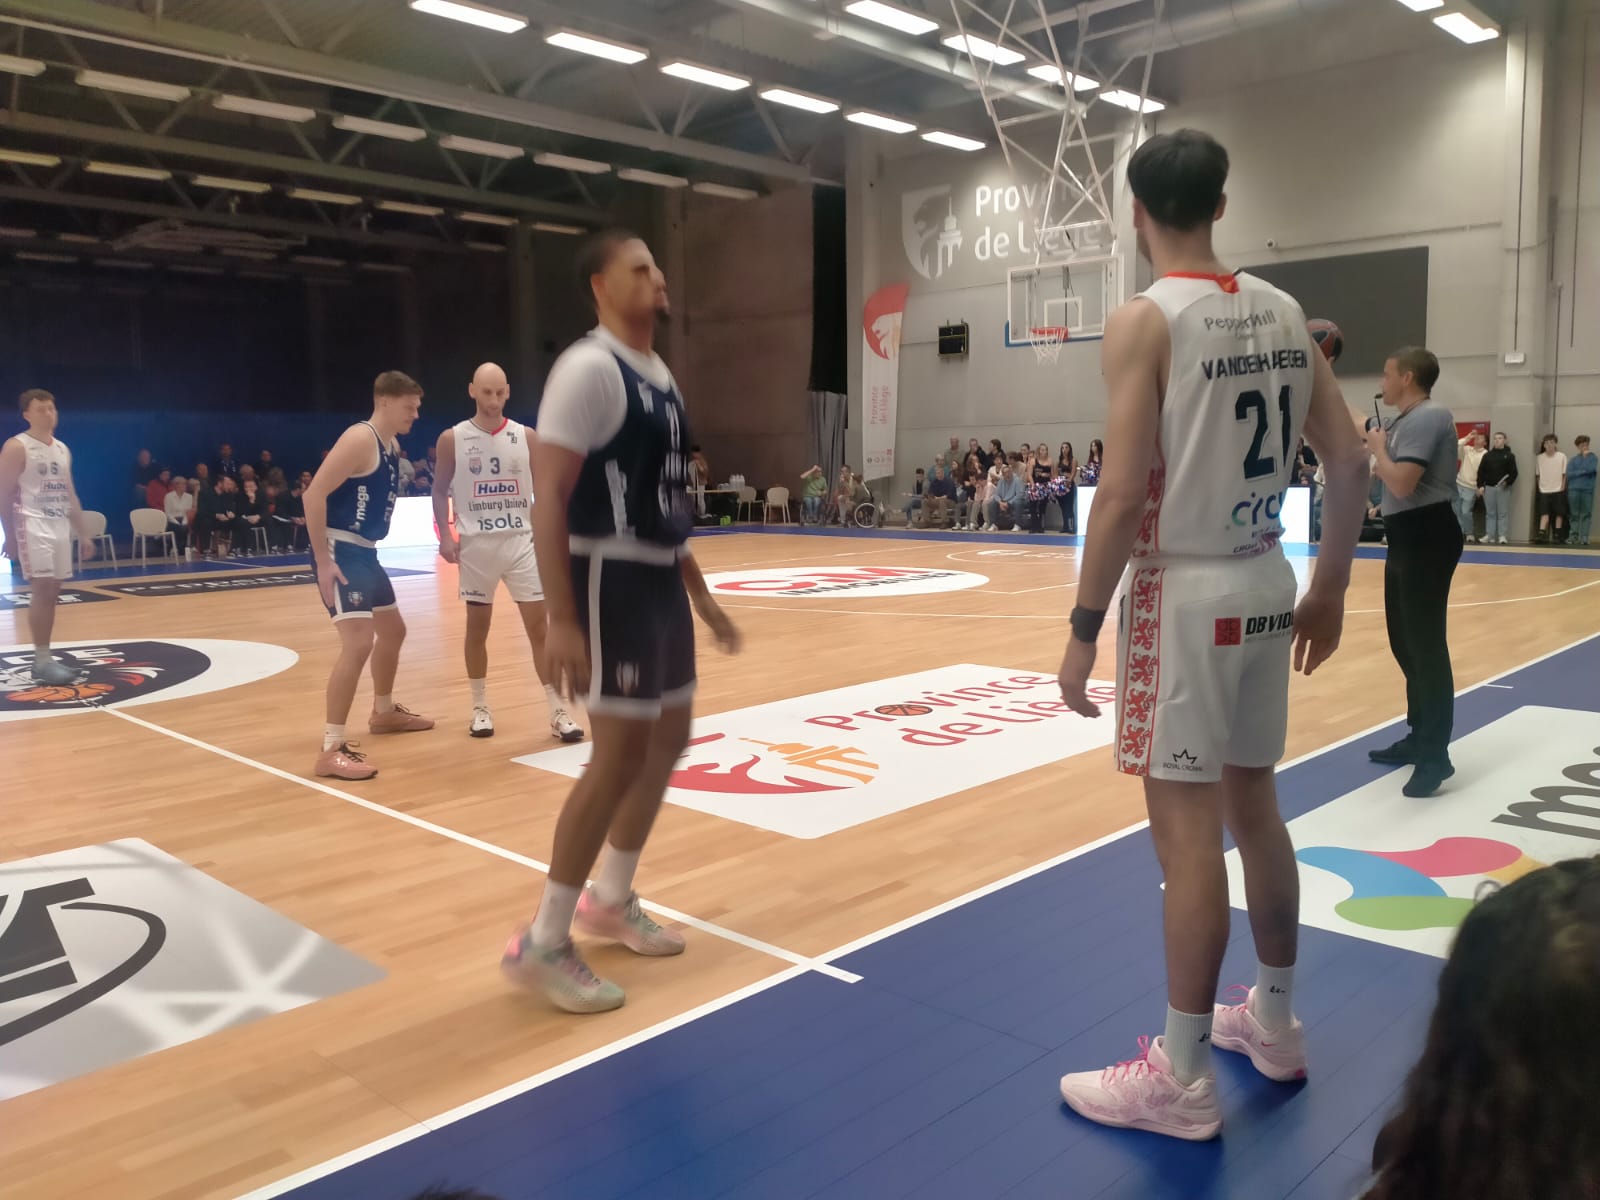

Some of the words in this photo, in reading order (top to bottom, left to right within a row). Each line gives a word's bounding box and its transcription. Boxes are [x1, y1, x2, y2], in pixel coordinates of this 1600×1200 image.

[974, 225, 1010, 260] de
[1235, 384, 1292, 480] 21
[490, 457, 500, 475] 3
[477, 482, 515, 494] Hubo
[356, 485, 369, 521] mega
[898, 722, 1004, 746] de
